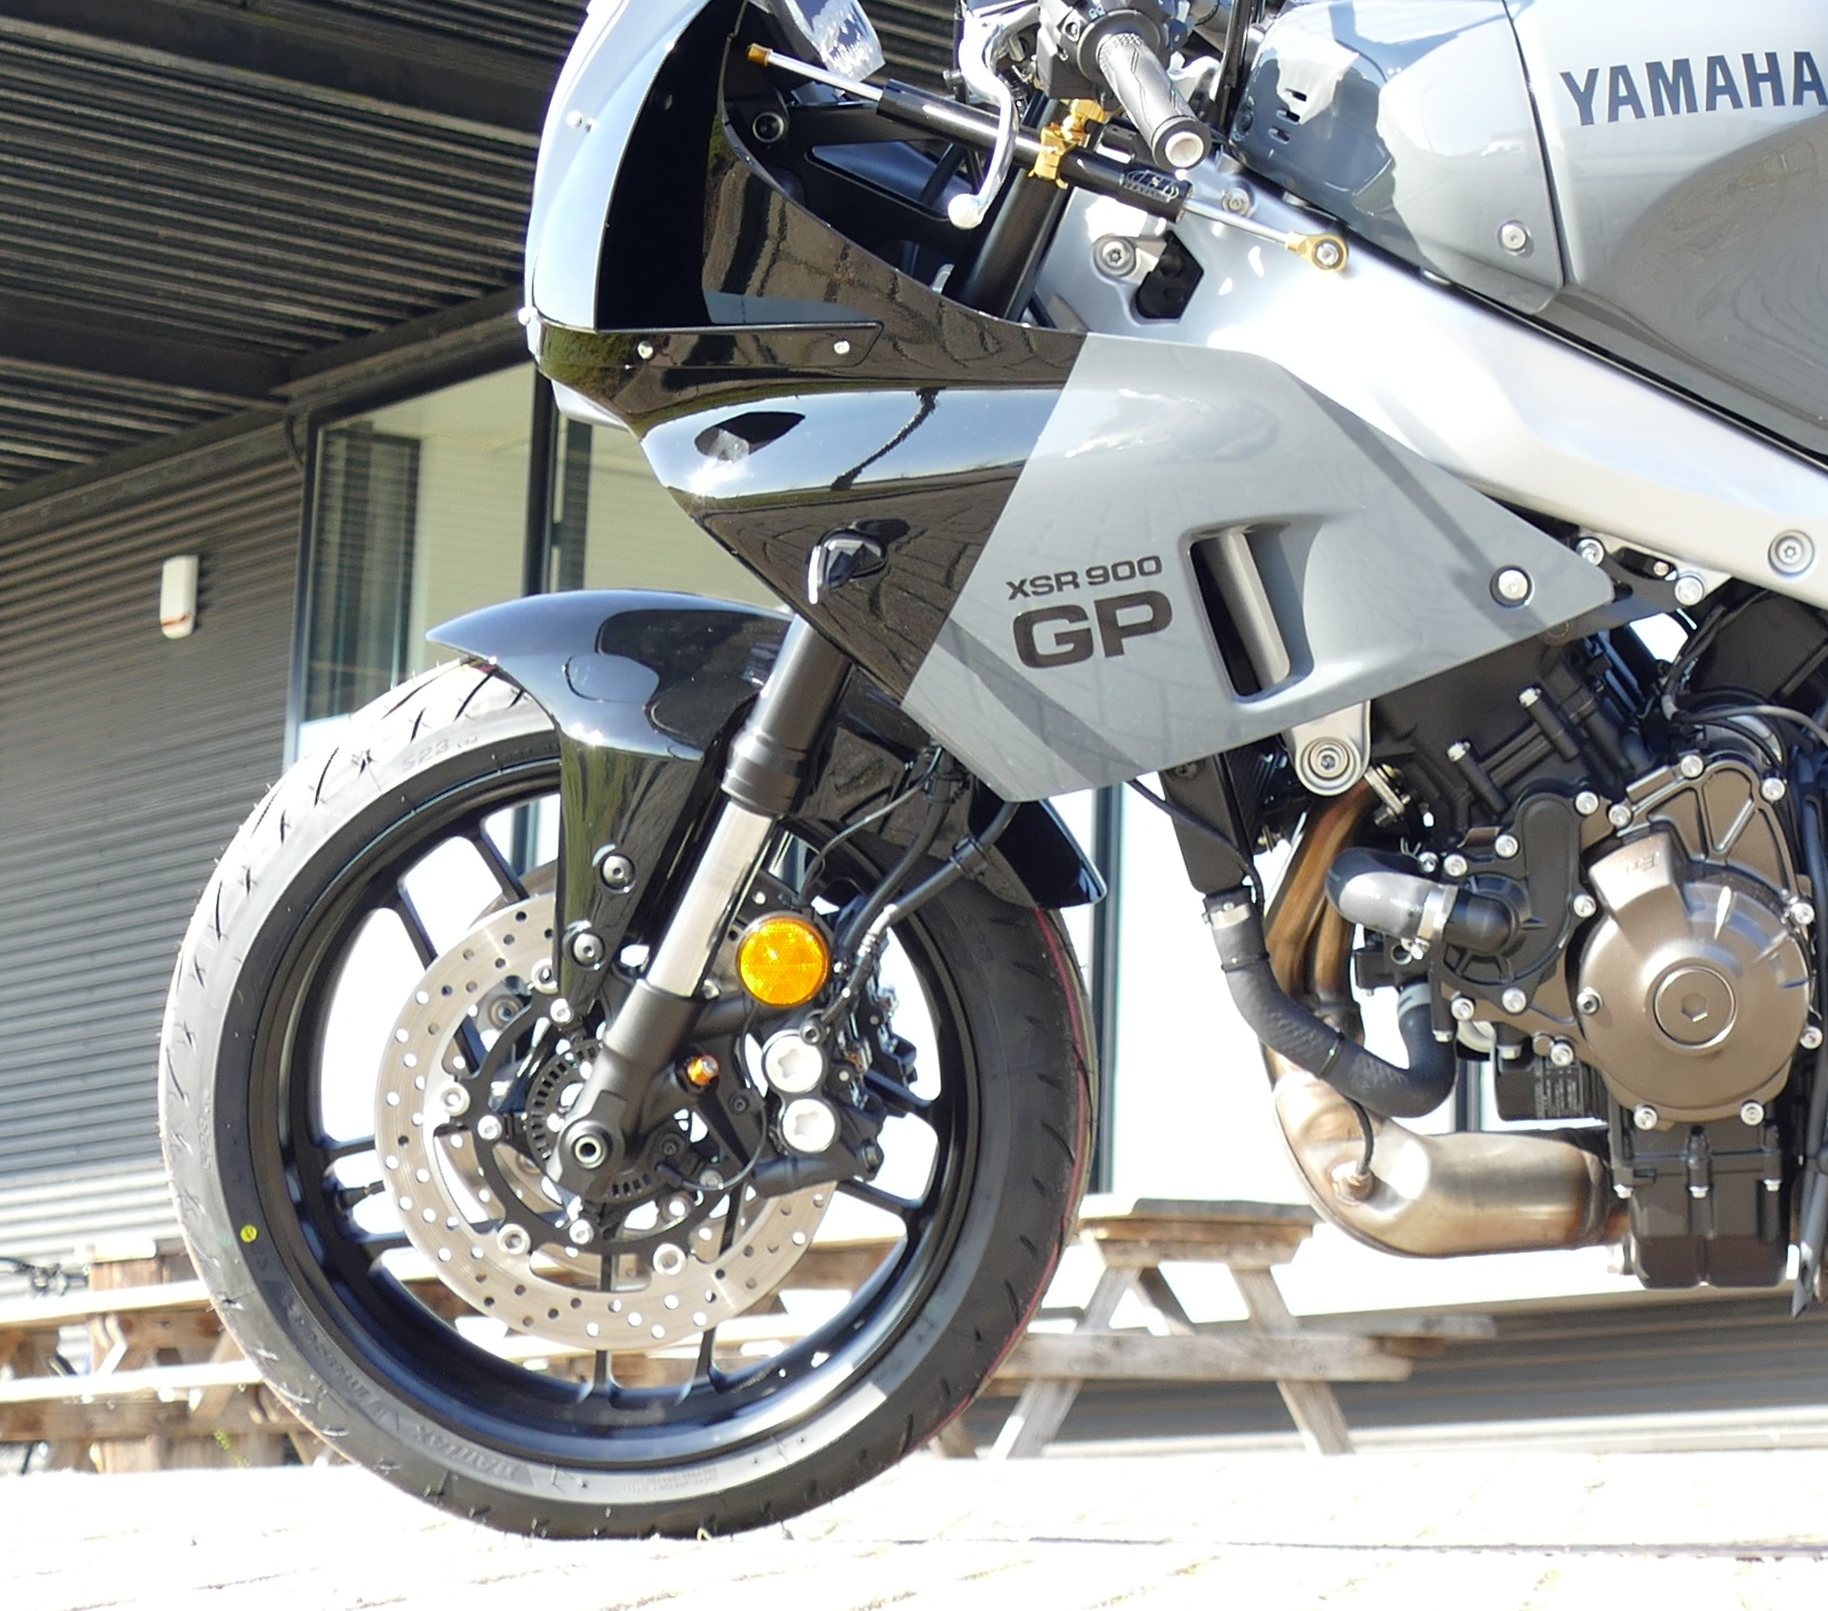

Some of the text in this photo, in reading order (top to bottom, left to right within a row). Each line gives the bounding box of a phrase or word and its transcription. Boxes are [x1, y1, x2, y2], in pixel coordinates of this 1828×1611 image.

[1559, 50, 1828, 127] YAMAHA
[1005, 555, 1163, 600] XSR 900
[1013, 590, 1173, 669] GP
